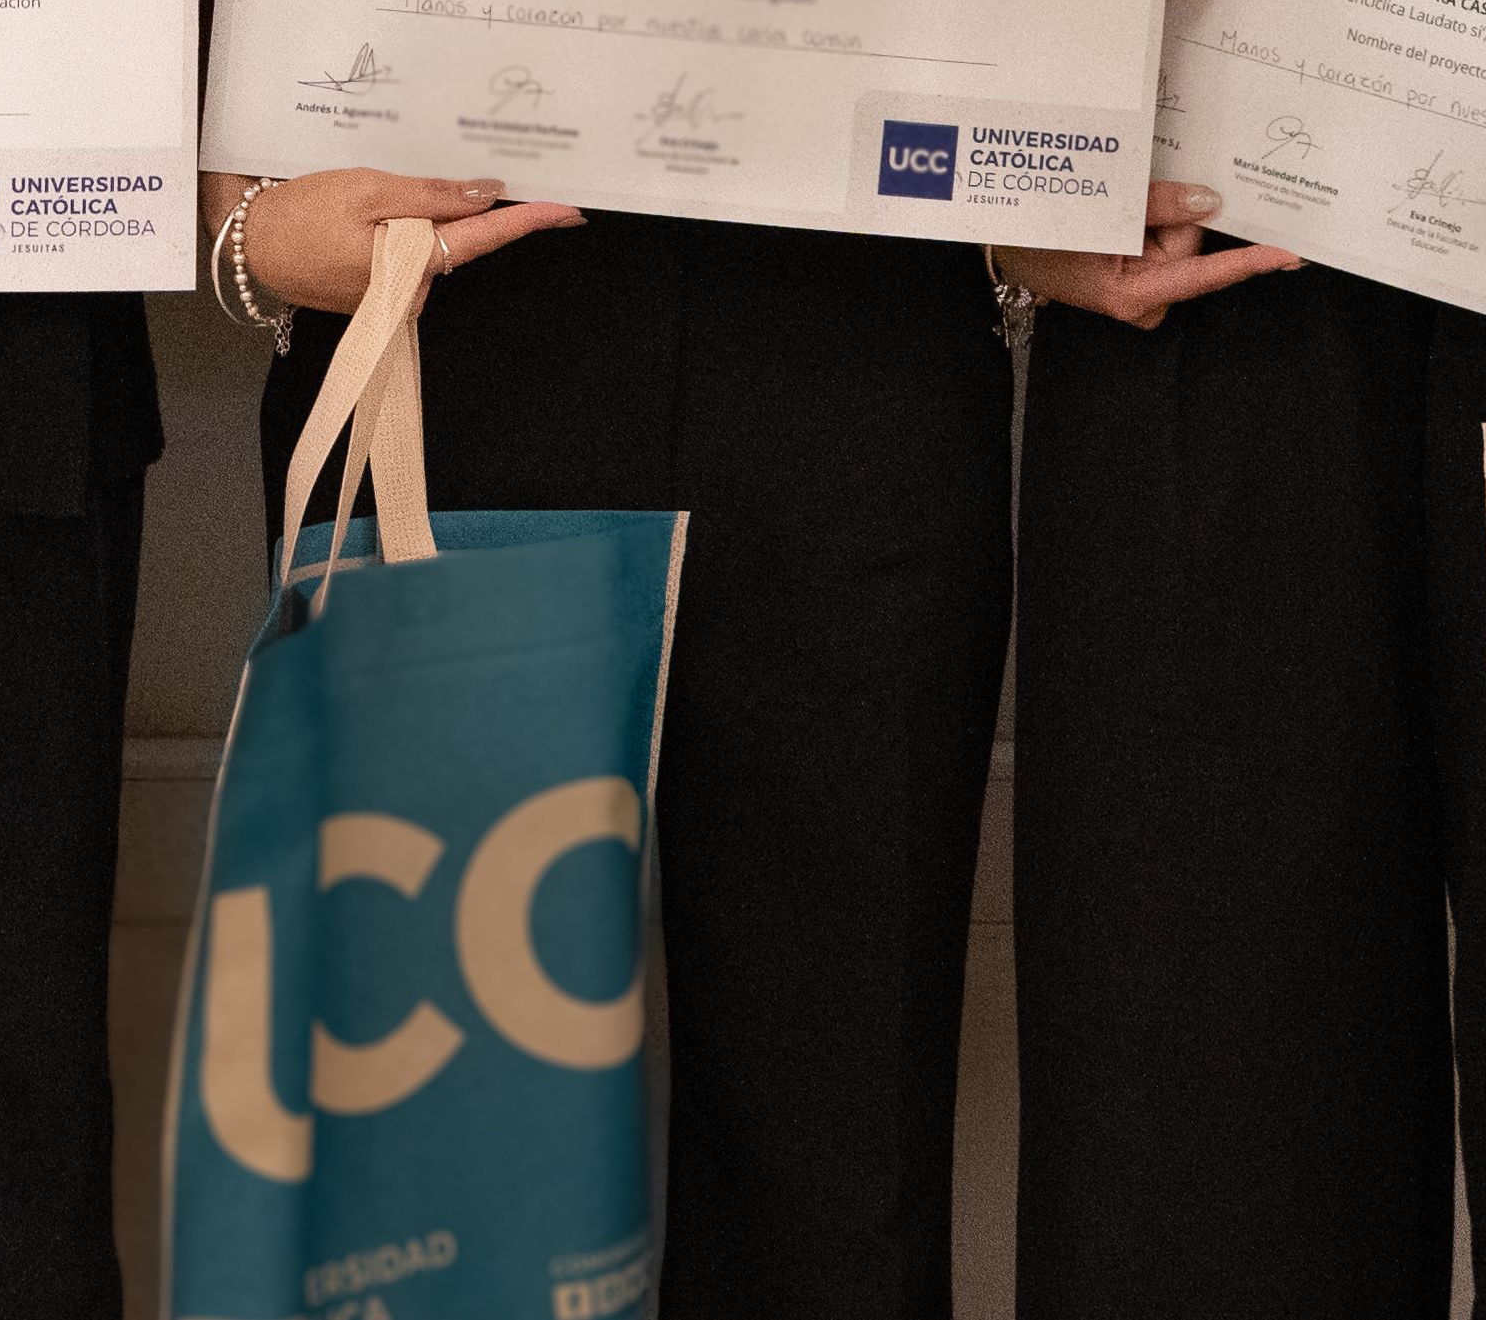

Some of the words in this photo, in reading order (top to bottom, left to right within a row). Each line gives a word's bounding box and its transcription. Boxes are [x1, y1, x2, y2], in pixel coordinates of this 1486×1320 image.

[972, 127, 1120, 154] UNIVERSIDAD
[888, 147, 949, 174] UCC
[969, 149, 1074, 173] CATÓLICA
[11, 175, 163, 194] UNIVERSIDAD
[967, 171, 996, 190] DE
[1002, 171, 1109, 197] CÓRDOBA
[10, 197, 118, 216] CATÓLICA
[967, 194, 1019, 207] JESUITAS
[10, 220, 39, 239] DE
[45, 217, 156, 238] CÓRDOBA
[12, 243, 65, 253] JESUITAS
